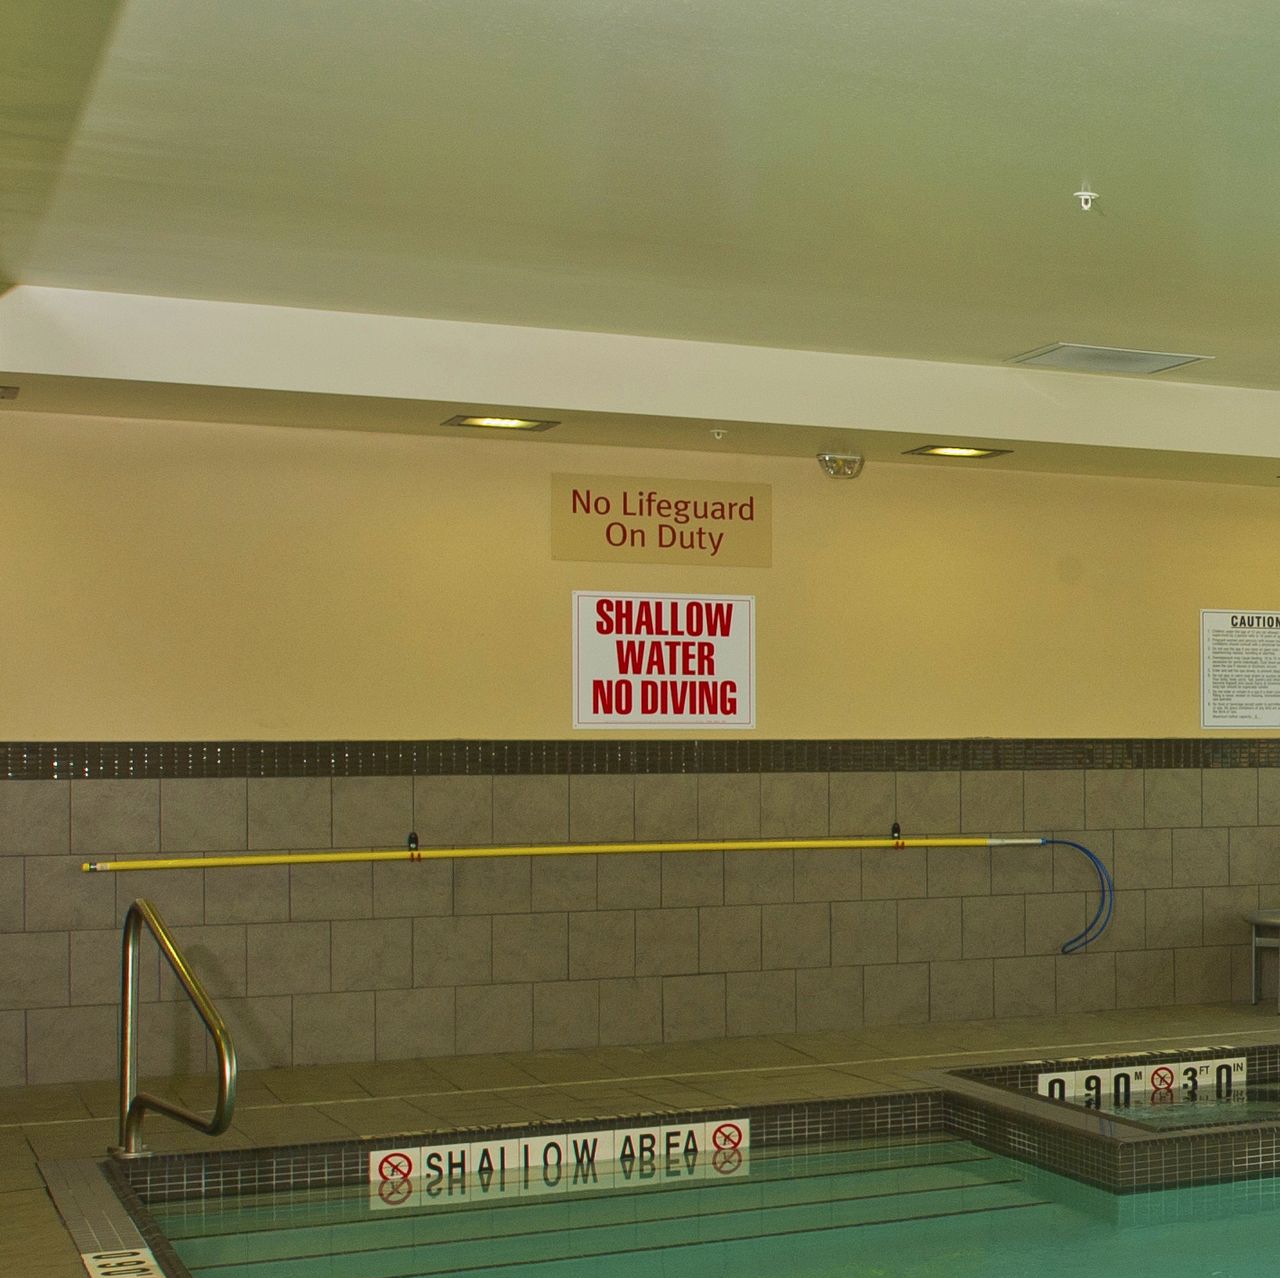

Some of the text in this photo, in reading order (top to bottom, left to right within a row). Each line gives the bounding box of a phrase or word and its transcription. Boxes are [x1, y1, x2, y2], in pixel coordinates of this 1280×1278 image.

[572, 489, 754, 524] No Lifeguard
[606, 522, 724, 556] On Duty
[596, 599, 733, 637] SHALLOW
[616, 640, 715, 676] WATER
[592, 679, 737, 715] NO DIVING
